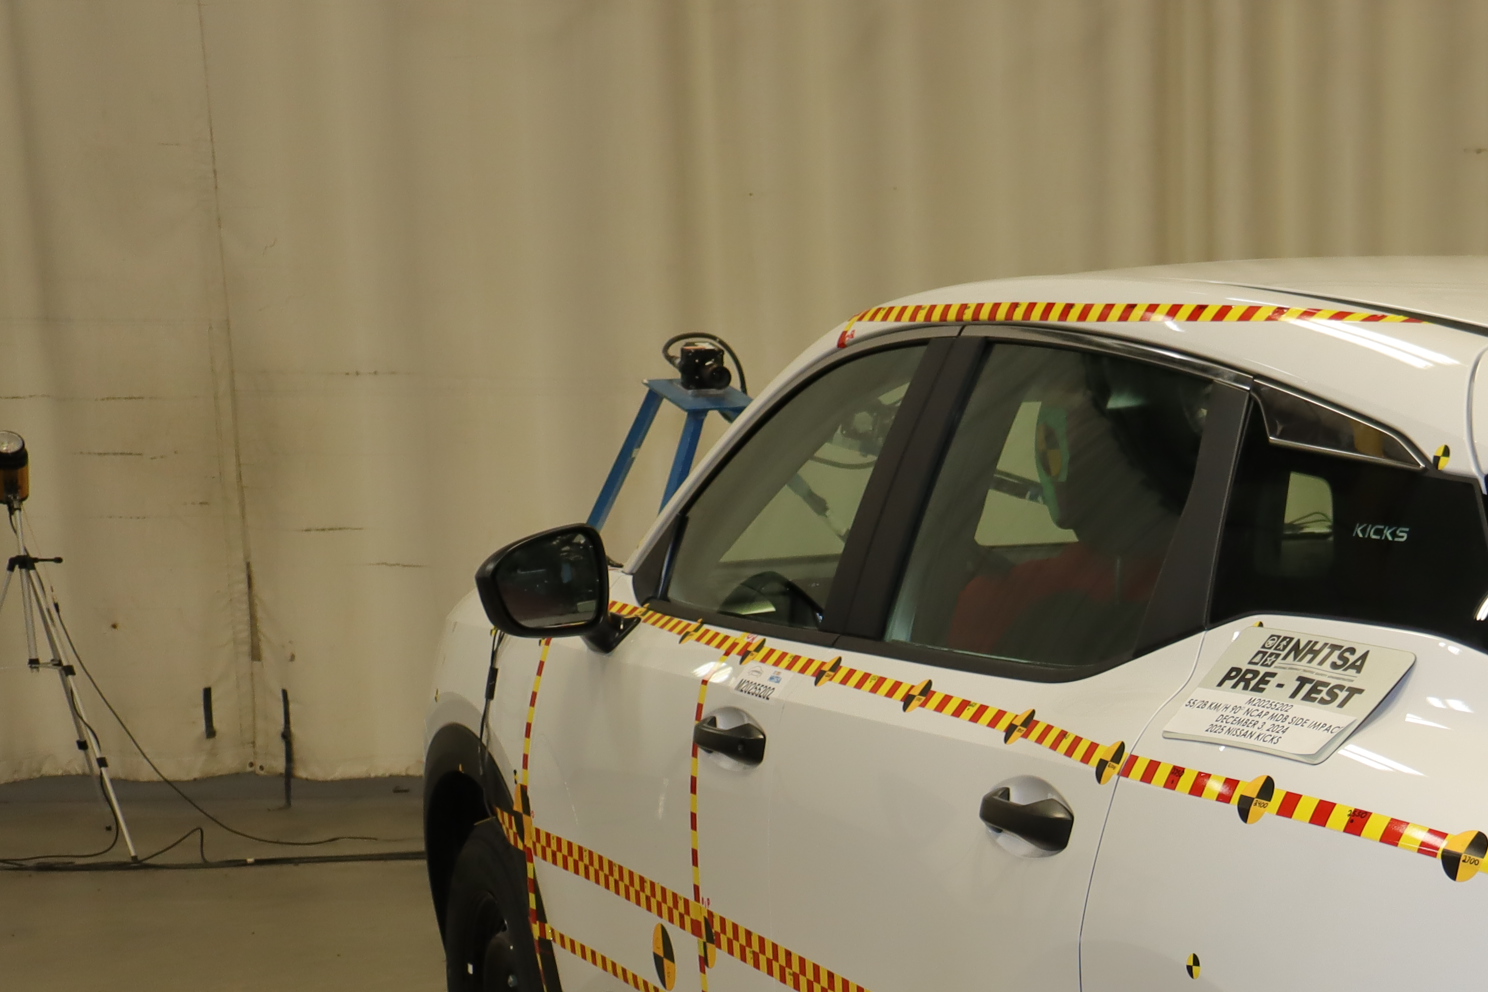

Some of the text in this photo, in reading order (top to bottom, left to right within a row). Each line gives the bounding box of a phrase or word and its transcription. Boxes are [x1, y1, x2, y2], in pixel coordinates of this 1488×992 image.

[1352, 523, 1410, 542] KICKS
[1282, 638, 1369, 674] NHTSA
[1217, 666, 1277, 693] PRE
[1289, 677, 1365, 708] TEST
[1245, 697, 1293, 712] M20255202
[1185, 698, 1209, 709] 55/28
[1206, 701, 1231, 713] KM/H
[1242, 708, 1270, 720] NCAP
[1267, 712, 1290, 723] MDB
[1288, 716, 1310, 728] SIDE
[1306, 720, 1344, 734] IMPAC
[1215, 714, 1259, 728] DECEMBER
[1266, 724, 1290, 734] 2024
[1205, 724, 1282, 744] 2025 NISSAN KICKS
[1462, 854, 1480, 866] 2700
